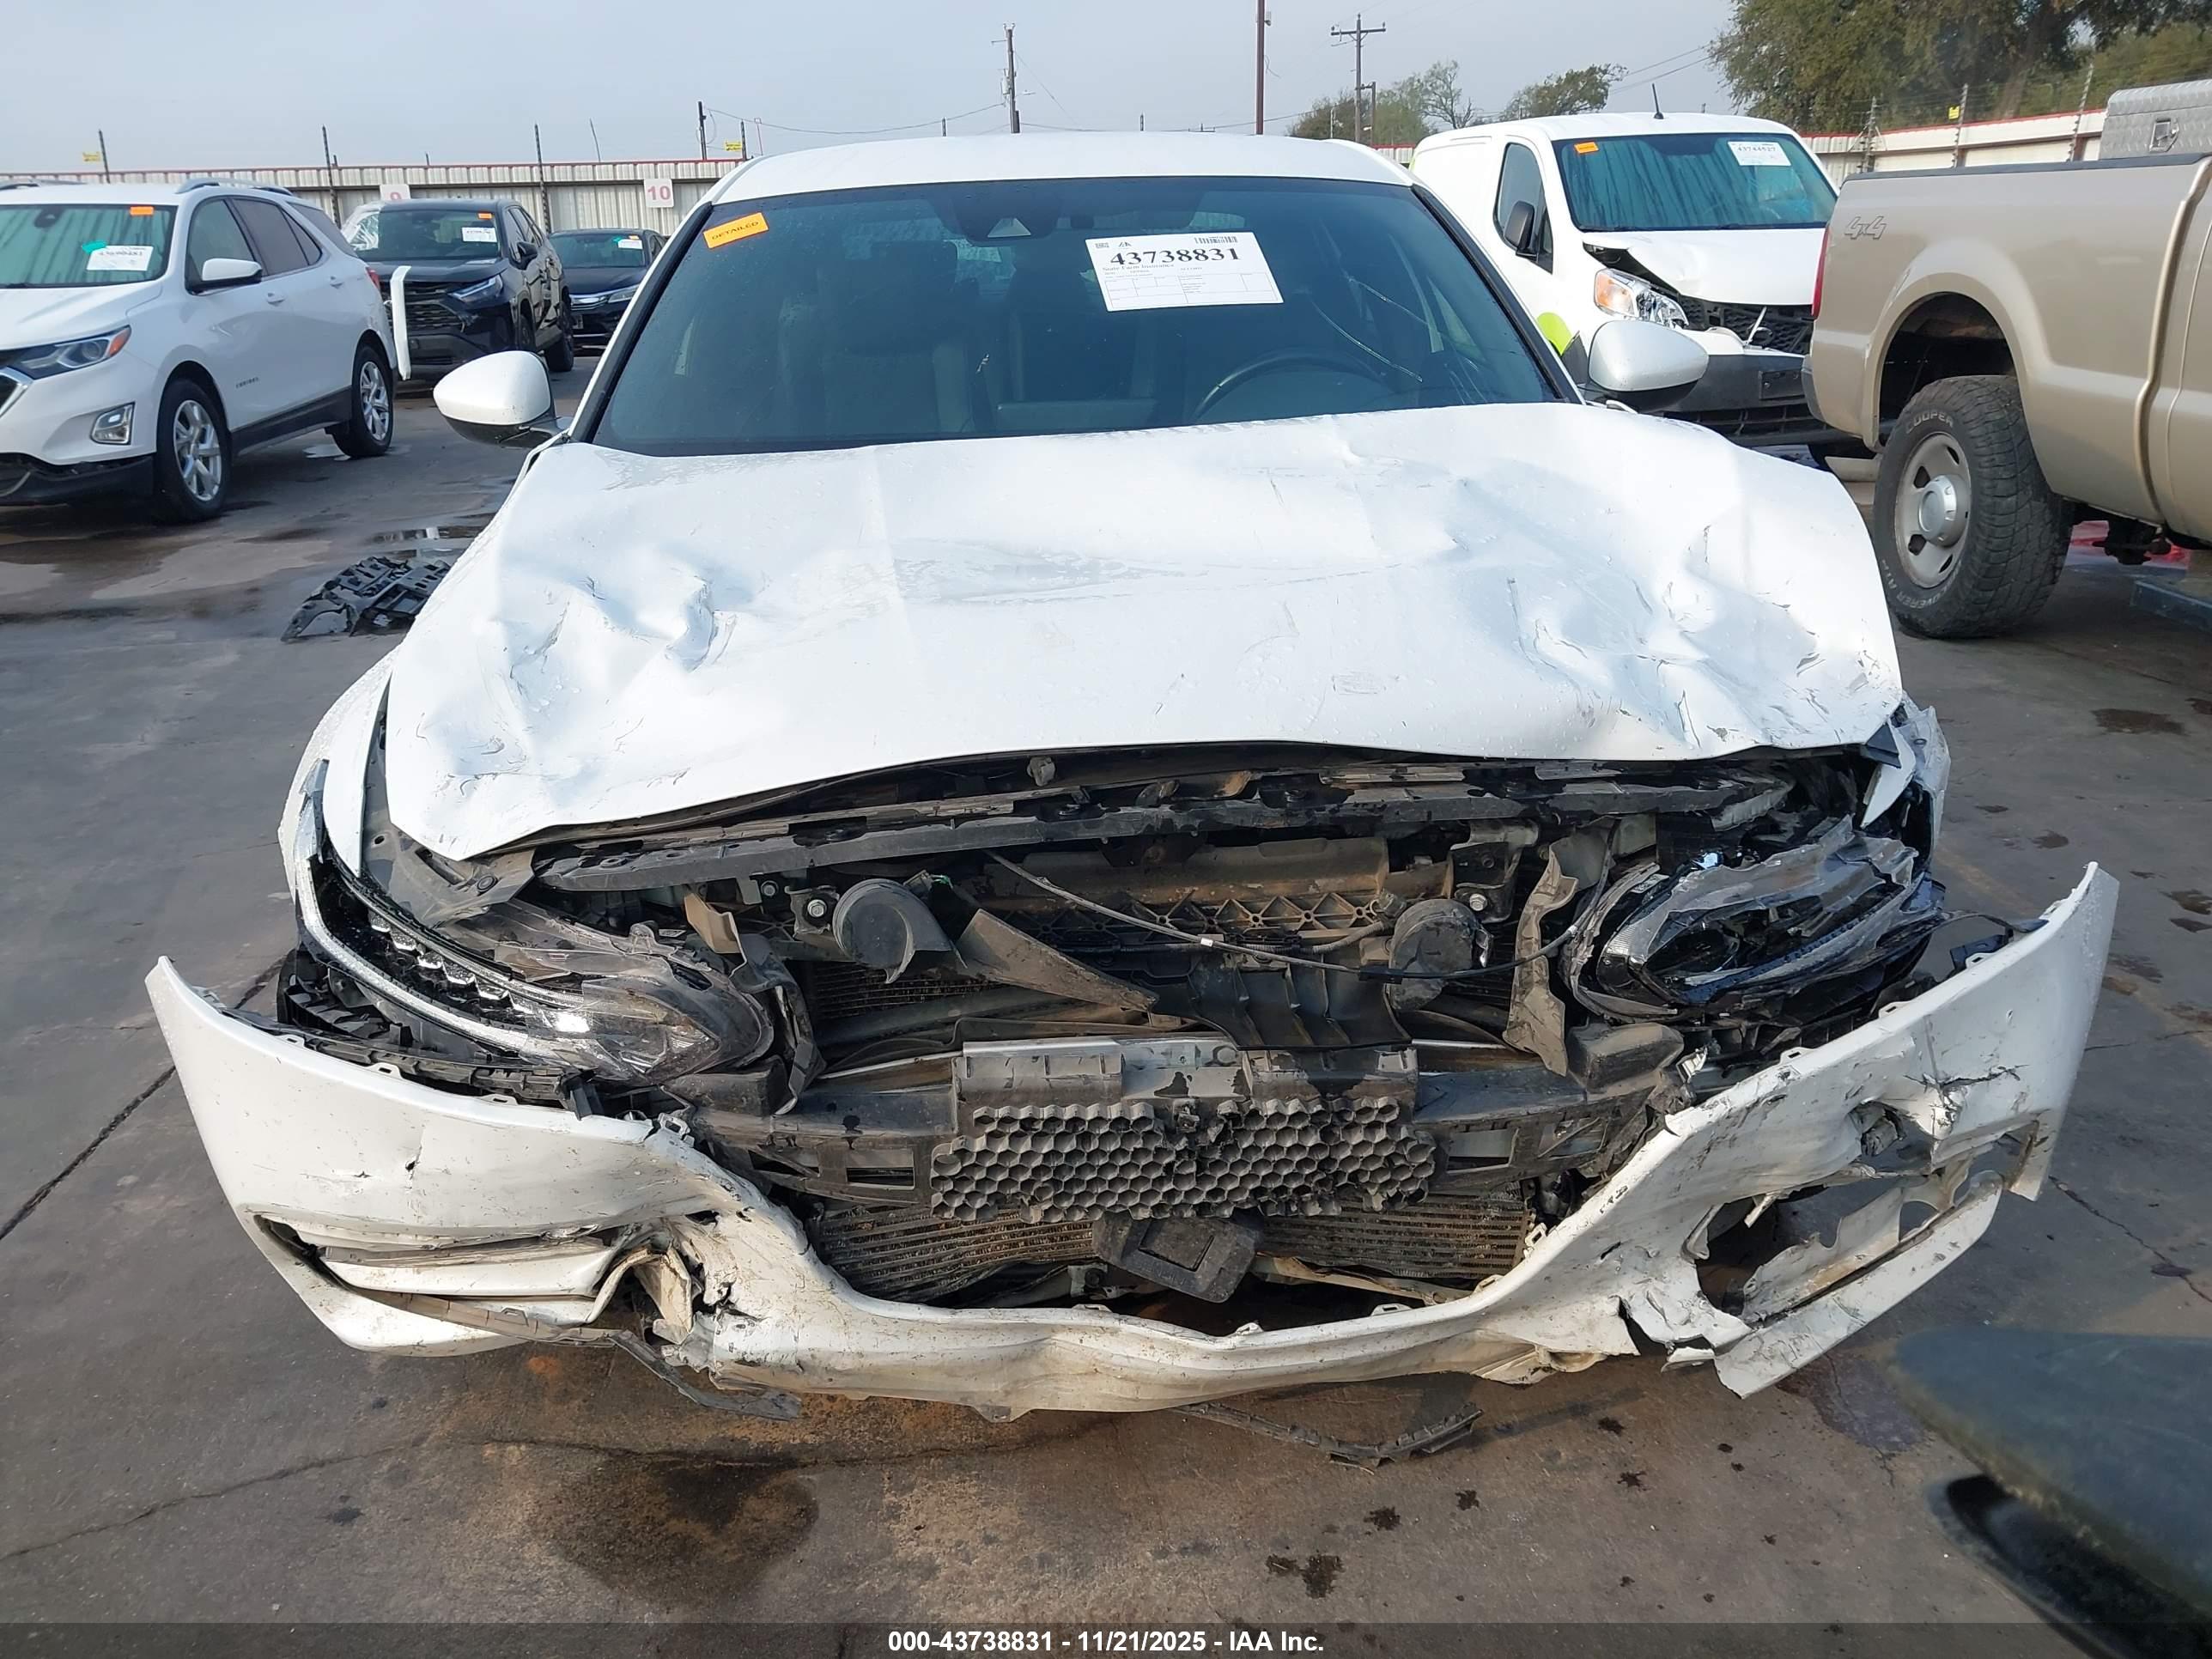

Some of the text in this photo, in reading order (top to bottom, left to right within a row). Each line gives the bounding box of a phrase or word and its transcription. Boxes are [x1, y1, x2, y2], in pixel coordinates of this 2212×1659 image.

[647, 185, 672, 201] 10
[712, 221, 759, 240] DETAILED
[1110, 247, 1241, 265] 43738831
[1906, 410, 1954, 434] COOPER
